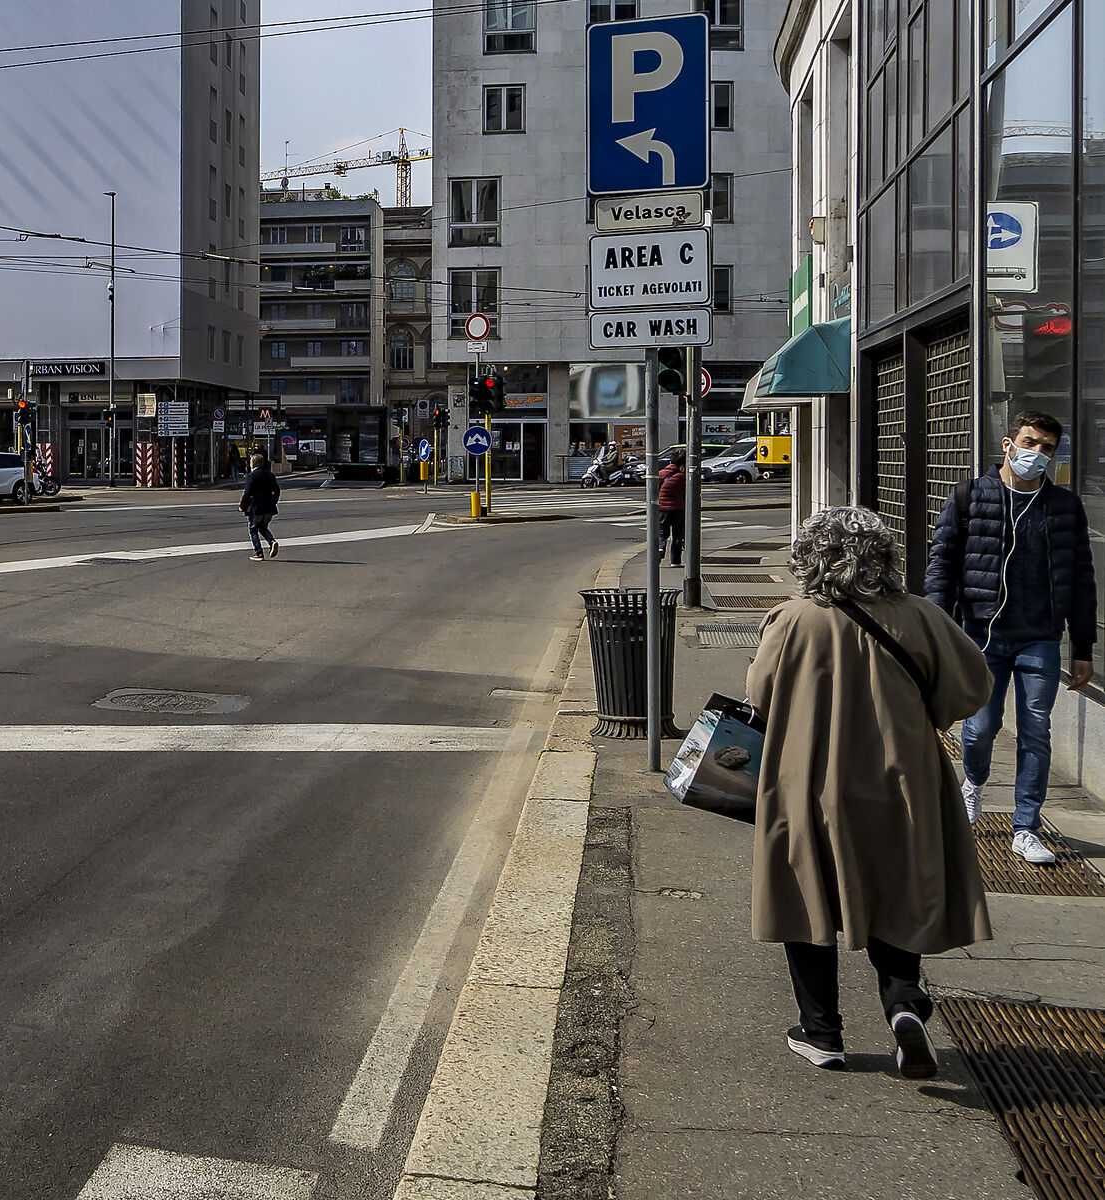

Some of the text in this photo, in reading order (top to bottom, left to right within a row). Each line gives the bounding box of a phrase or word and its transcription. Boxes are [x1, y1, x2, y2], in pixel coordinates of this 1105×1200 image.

[612, 31, 684, 123] P
[611, 204, 686, 221] Velasca
[605, 243, 694, 269] AREA C
[597, 281, 702, 297] TICKET AGEVOLATI
[603, 318, 698, 338] CAR WASH
[65, 363, 100, 374] VISION
[705, 425, 731, 433] FedEx
